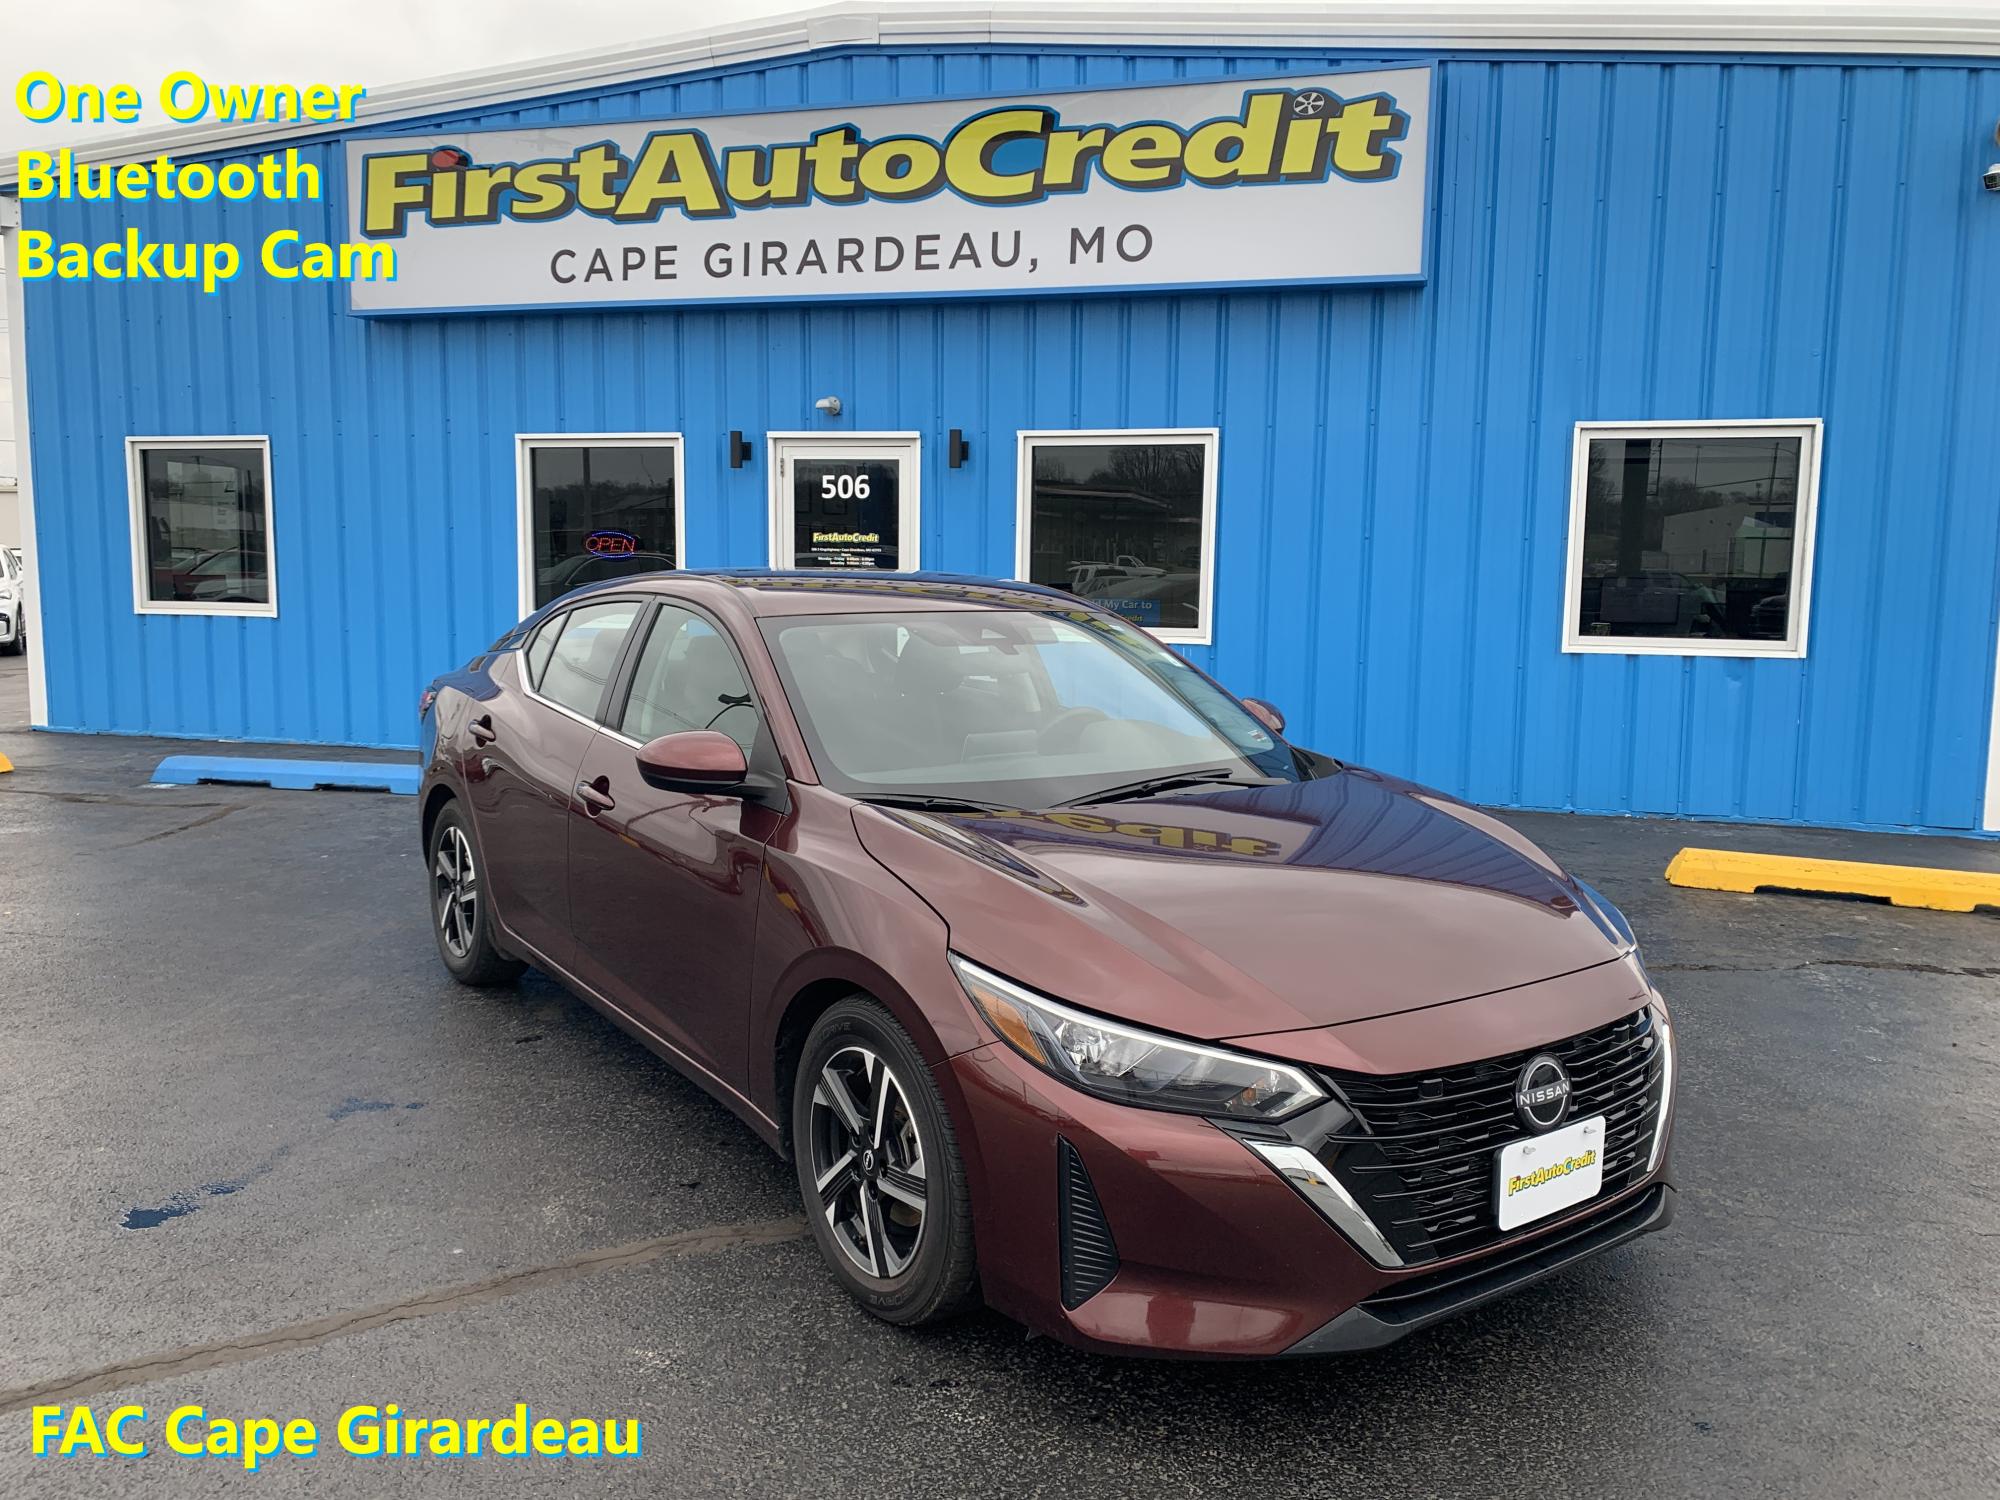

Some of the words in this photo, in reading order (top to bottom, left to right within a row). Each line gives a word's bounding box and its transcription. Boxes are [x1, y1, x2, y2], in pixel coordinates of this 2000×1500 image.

[366, 92, 1402, 236] FirstAutoCredit
[551, 245, 678, 284] CAPE
[705, 230, 1037, 278] GIRARDEAU,
[1070, 225, 1153, 264] MO
[821, 474, 871, 499] 506
[585, 536, 636, 554] OPEN
[813, 532, 880, 544] FirstAutoCredit
[1103, 600, 1119, 611] My
[1121, 600, 1138, 609] Car
[1141, 601, 1152, 609] to
[1519, 1081, 1570, 1106] NISSAN
[1507, 1148, 1597, 1197] FirstAutoCredit
